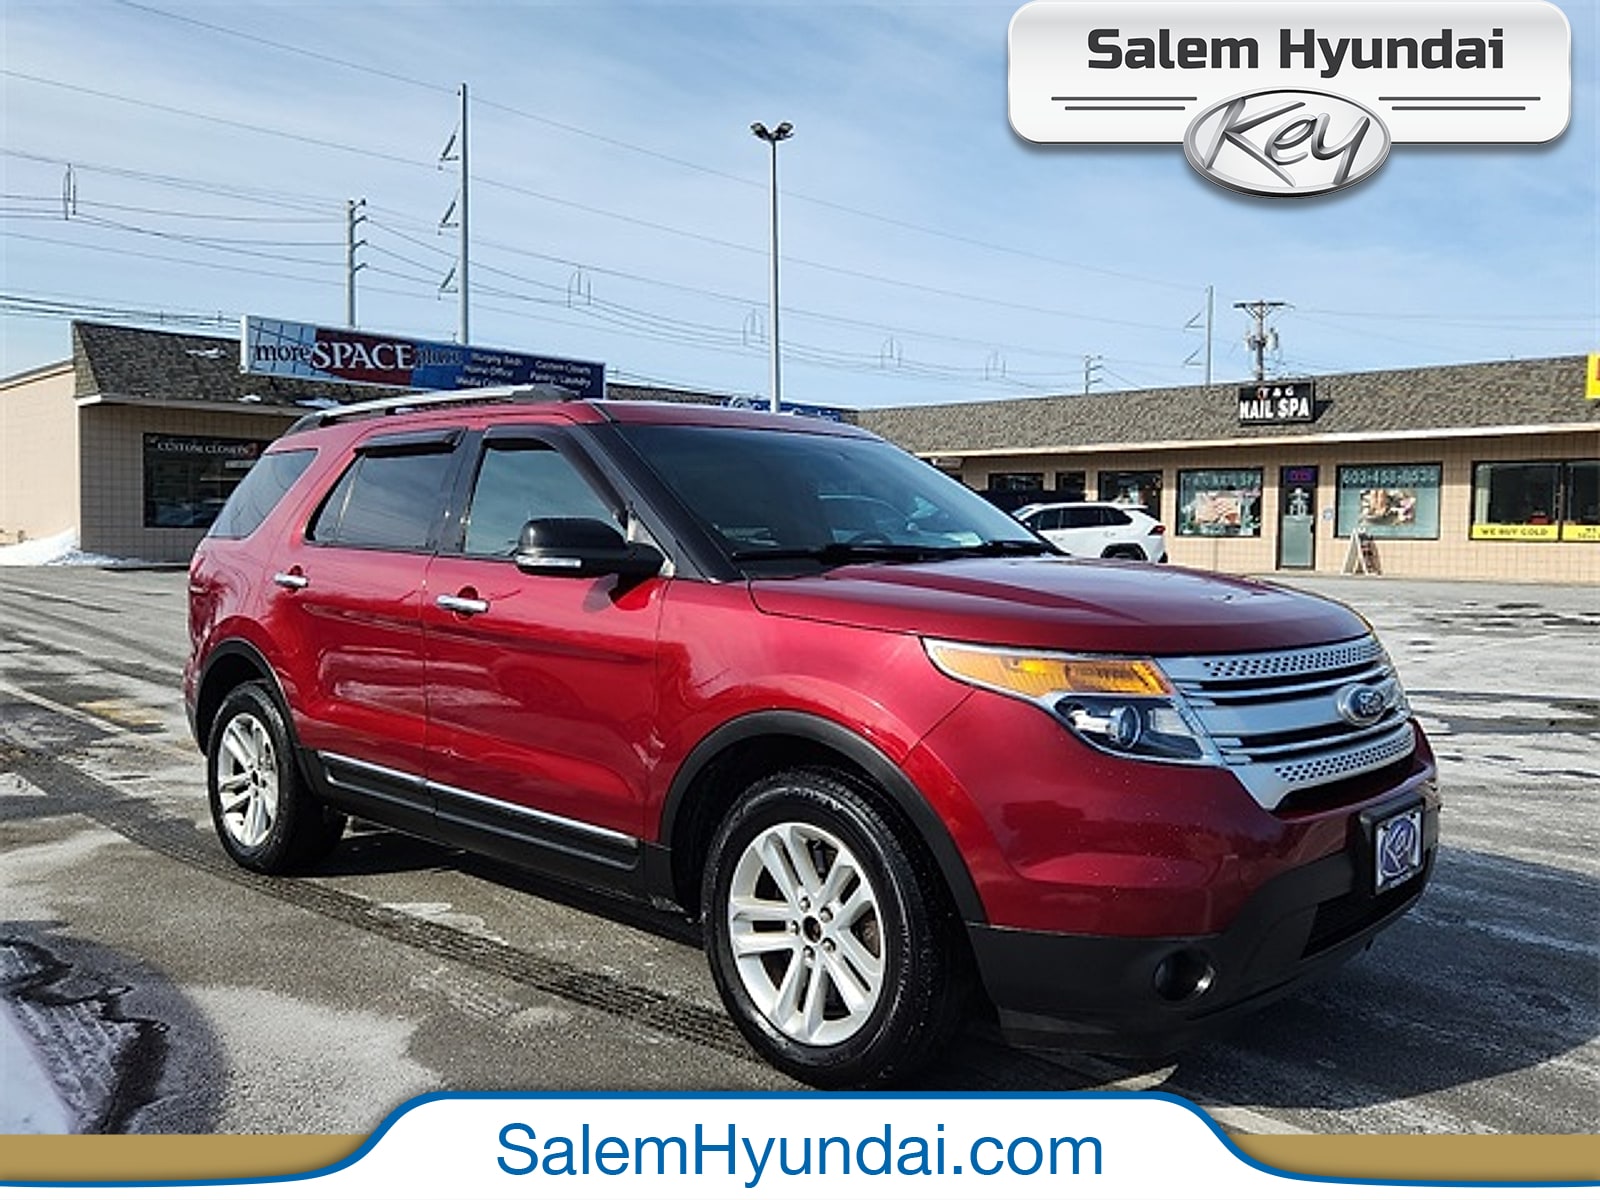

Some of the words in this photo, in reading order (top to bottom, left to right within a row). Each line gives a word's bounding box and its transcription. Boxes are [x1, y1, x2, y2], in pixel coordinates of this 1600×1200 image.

[311, 341, 415, 371] SPACE
[1240, 399, 1274, 419] NAIL
[1277, 397, 1310, 418] SPA
